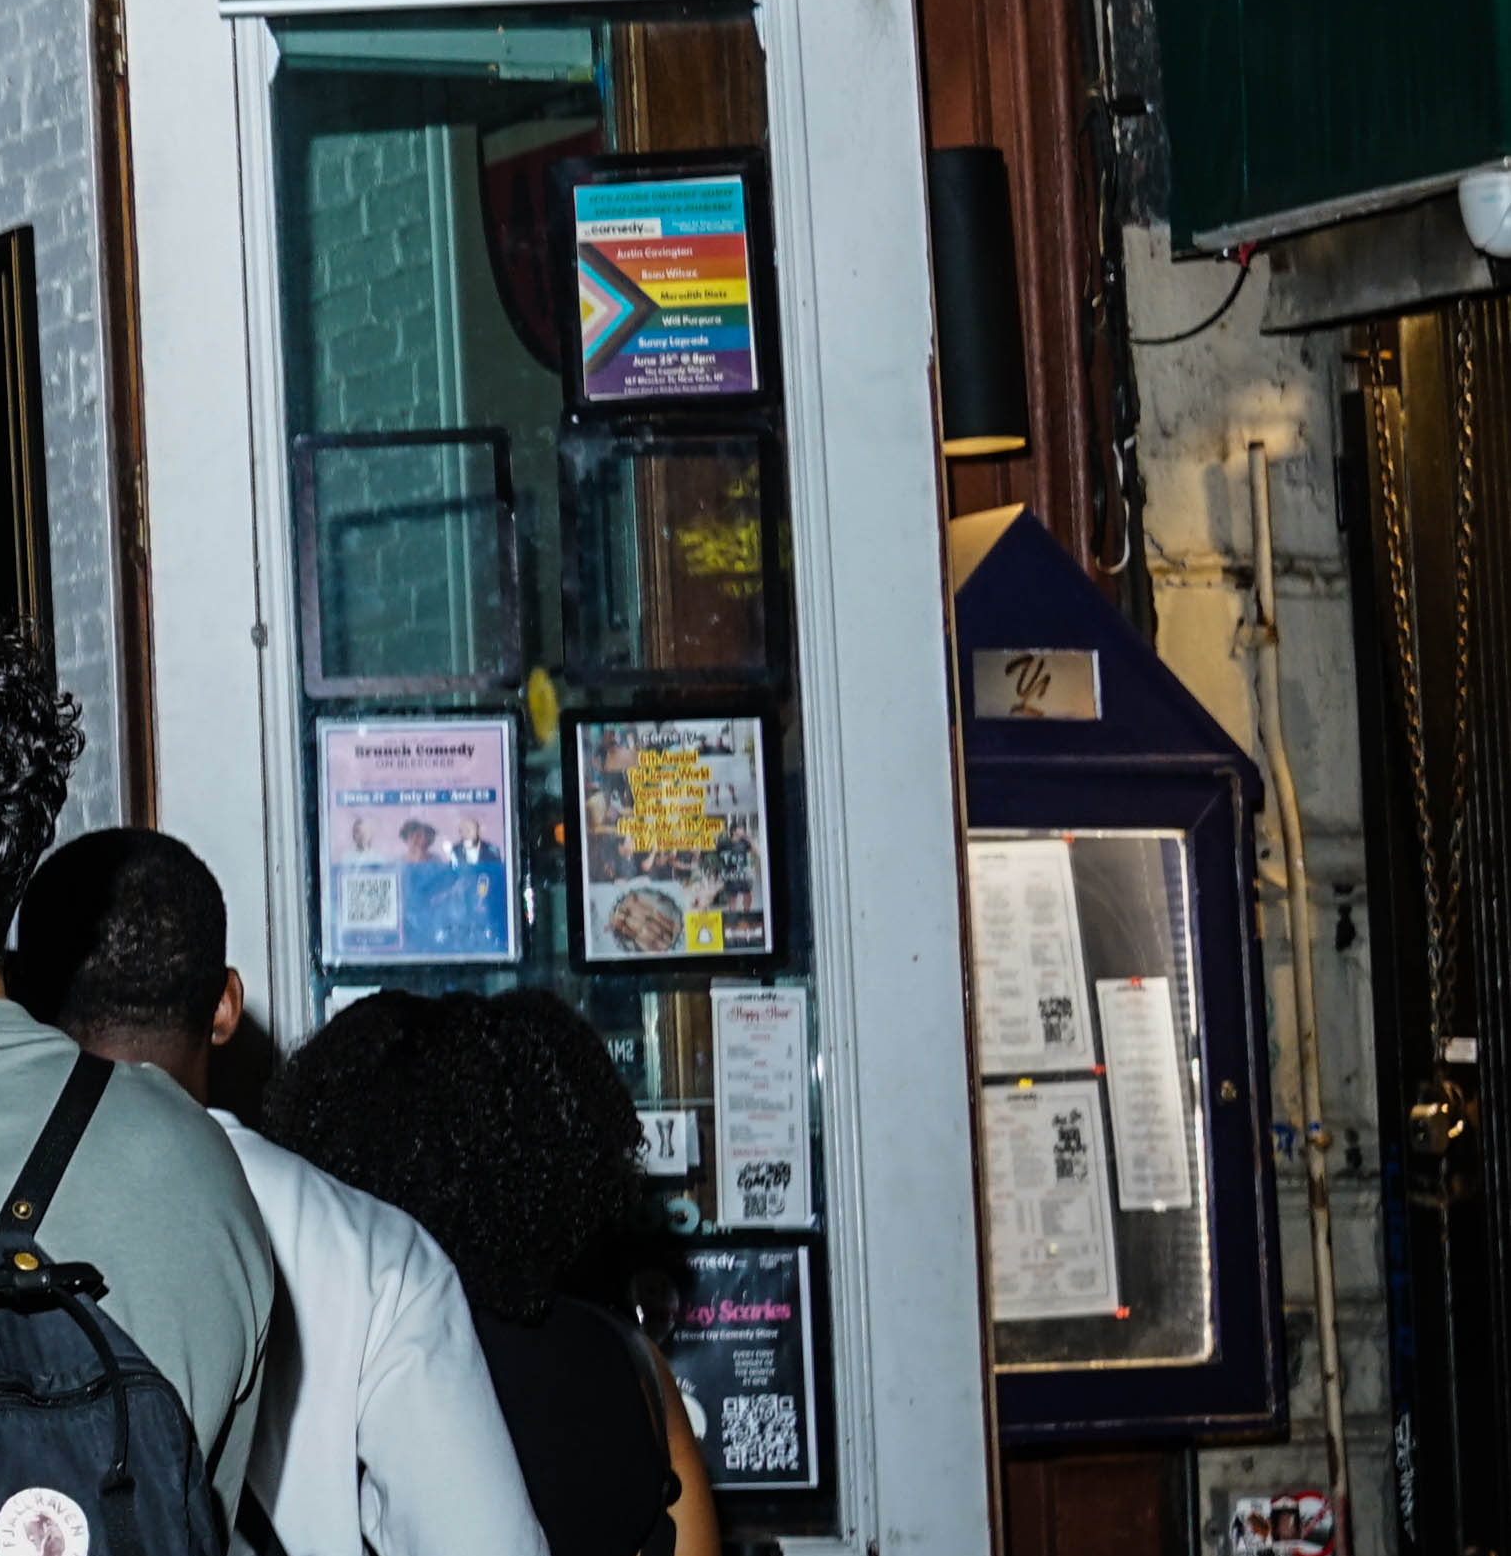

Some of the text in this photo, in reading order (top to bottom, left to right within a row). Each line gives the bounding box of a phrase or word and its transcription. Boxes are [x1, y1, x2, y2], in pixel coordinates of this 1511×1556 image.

[616, 246, 694, 261] Justin Covington
[661, 314, 681, 327] Will
[632, 354, 657, 368] June
[354, 742, 476, 760] Brunch Comedy
[718, 1298, 793, 1323] Scaries
